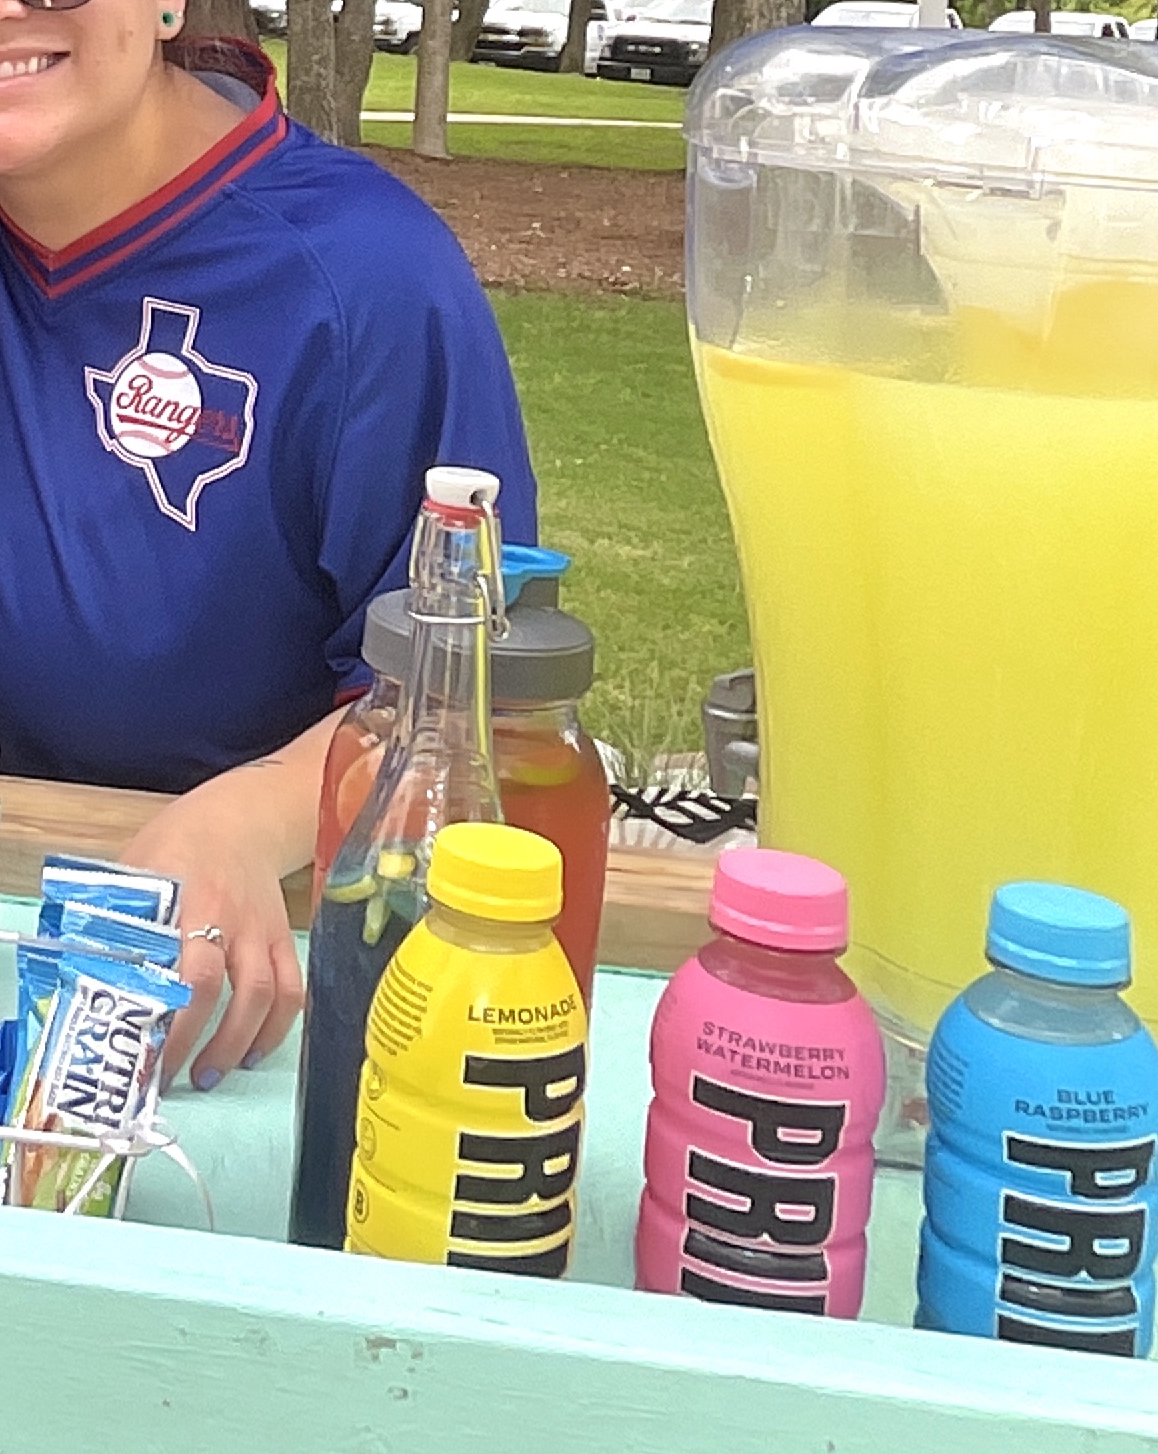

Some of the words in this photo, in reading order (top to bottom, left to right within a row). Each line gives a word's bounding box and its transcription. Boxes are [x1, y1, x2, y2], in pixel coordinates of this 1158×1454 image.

[116, 375, 239, 444] Rang
[468, 994, 578, 1025] LEMONADE
[702, 1020, 846, 1062] STRAWBERRY
[57, 988, 117, 1124] GRAIN
[93, 996, 153, 1129] NUTRI
[696, 1036, 850, 1080] WATERMELON
[1014, 1099, 1149, 1124] RASPBERRY
[1056, 1088, 1116, 1105] BLUE
[446, 1043, 586, 1279] PRI
[679, 1074, 849, 1316] PRI
[996, 1133, 1157, 1358] PRI
